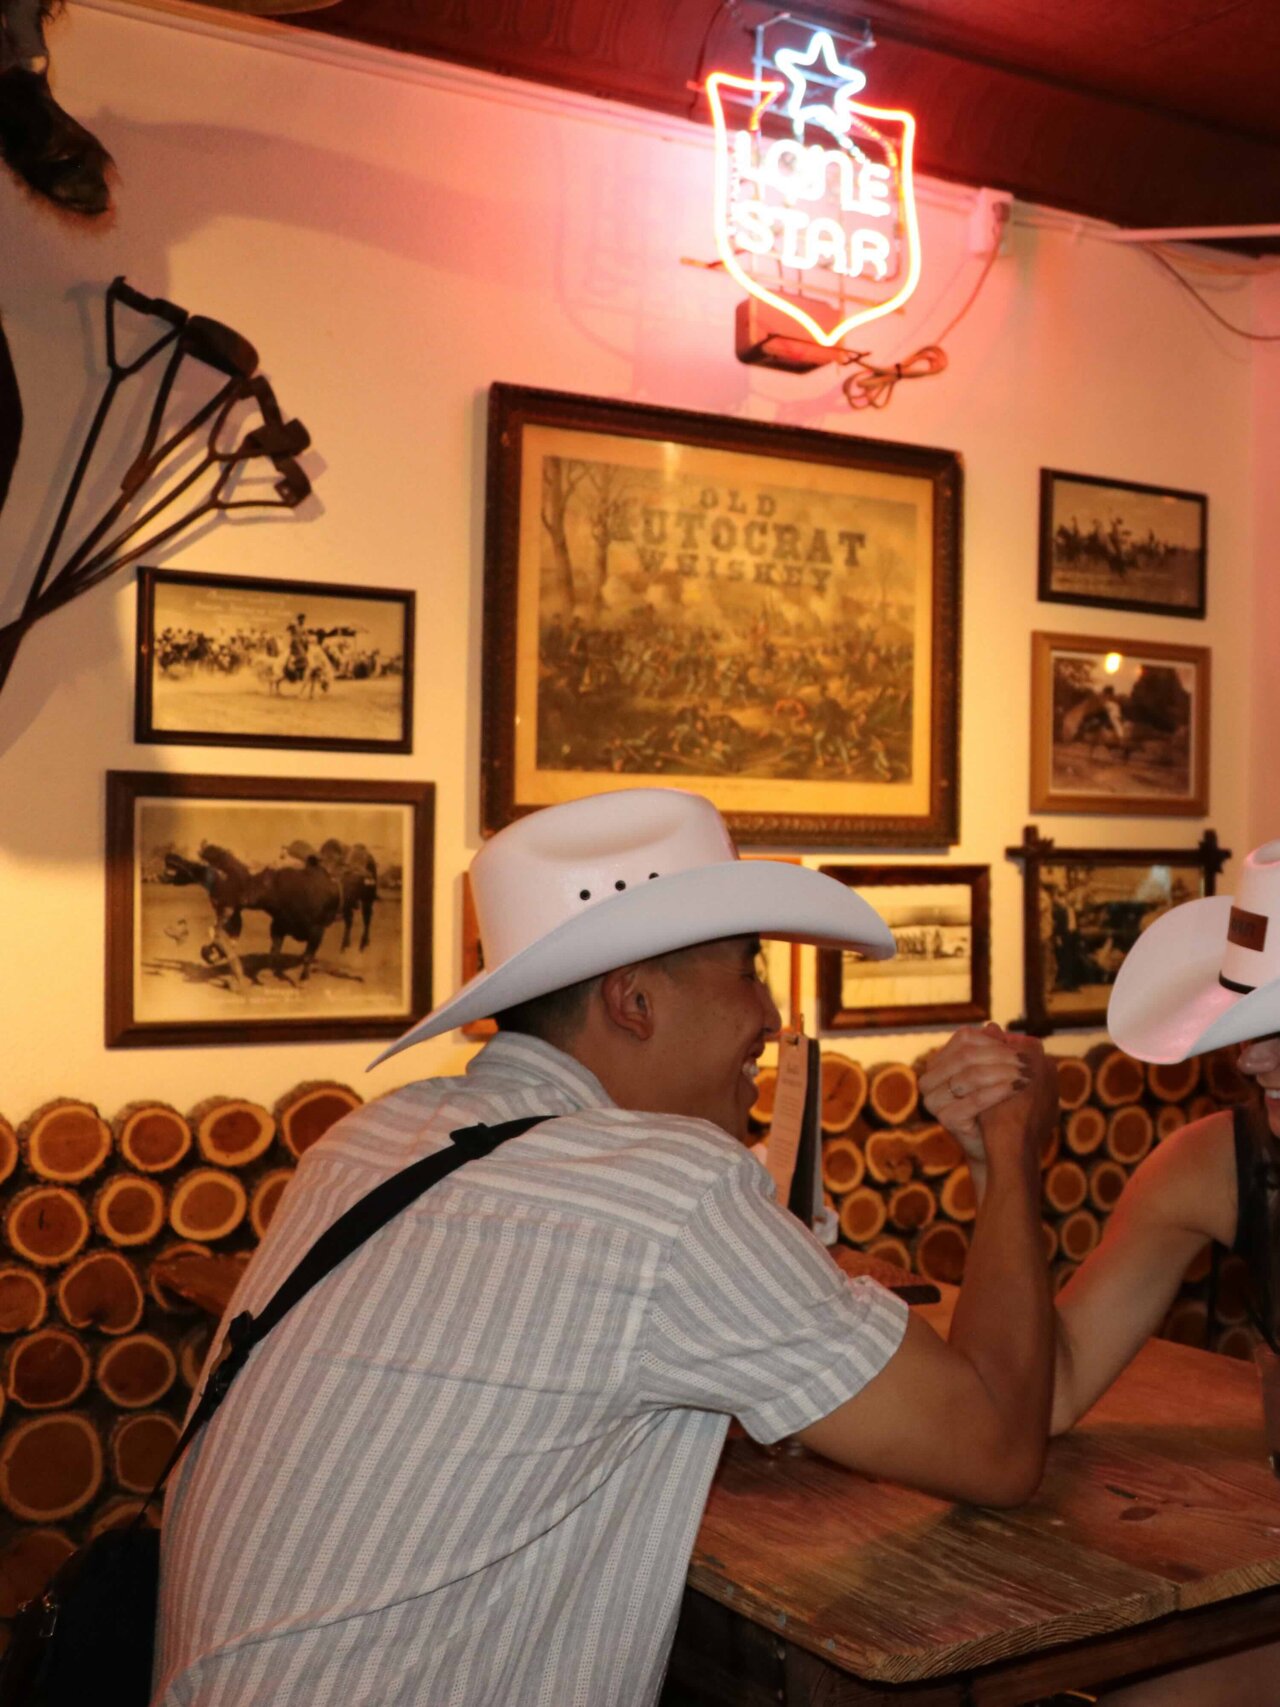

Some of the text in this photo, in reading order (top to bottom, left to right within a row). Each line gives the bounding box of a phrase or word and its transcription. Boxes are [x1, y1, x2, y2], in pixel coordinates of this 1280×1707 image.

[735, 131, 891, 216] LONE
[731, 200, 891, 279] STAR
[700, 487, 777, 518] OLD
[637, 548, 832, 592] WHISKEY
